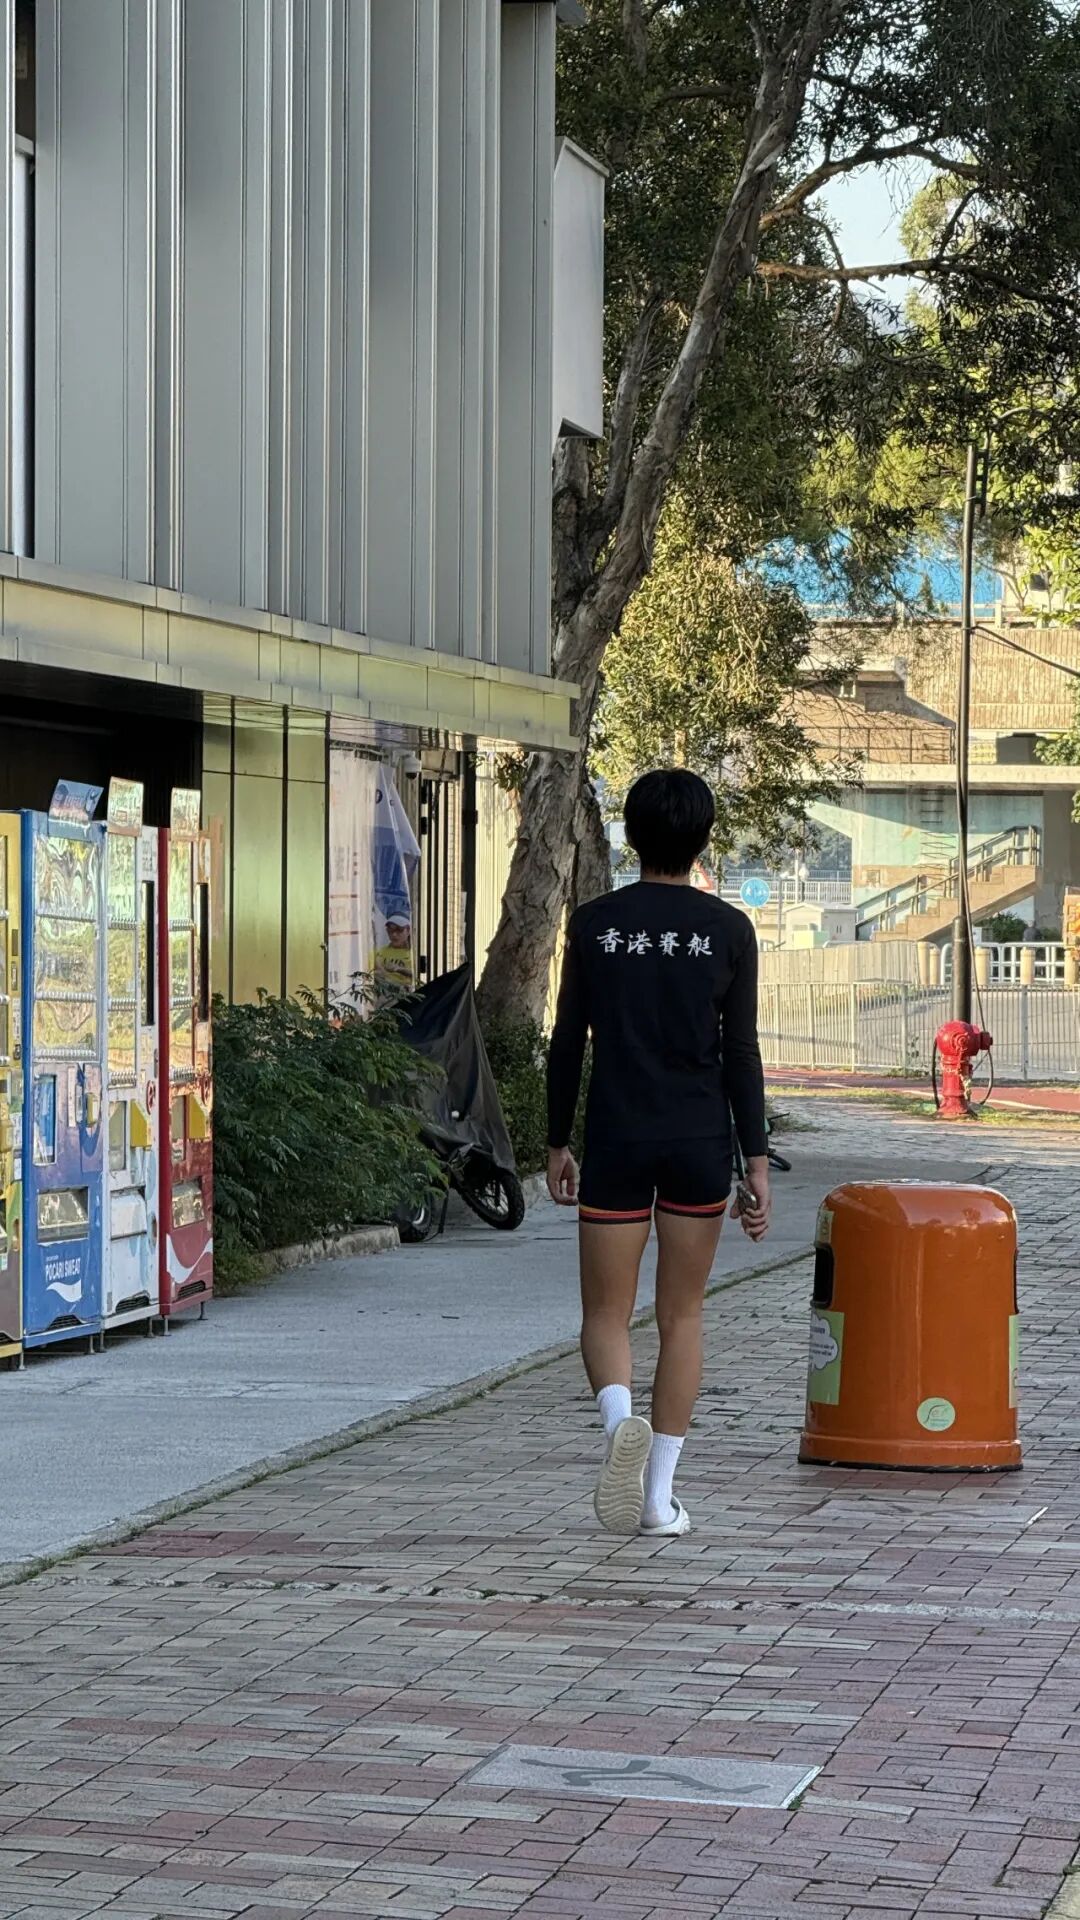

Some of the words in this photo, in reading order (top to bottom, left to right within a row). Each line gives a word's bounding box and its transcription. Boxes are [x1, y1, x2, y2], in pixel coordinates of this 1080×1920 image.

[596, 927, 713, 957] 香港賽艇
[45, 1262, 64, 1282] POCARI
[65, 1257, 81, 1276] SWEAT
